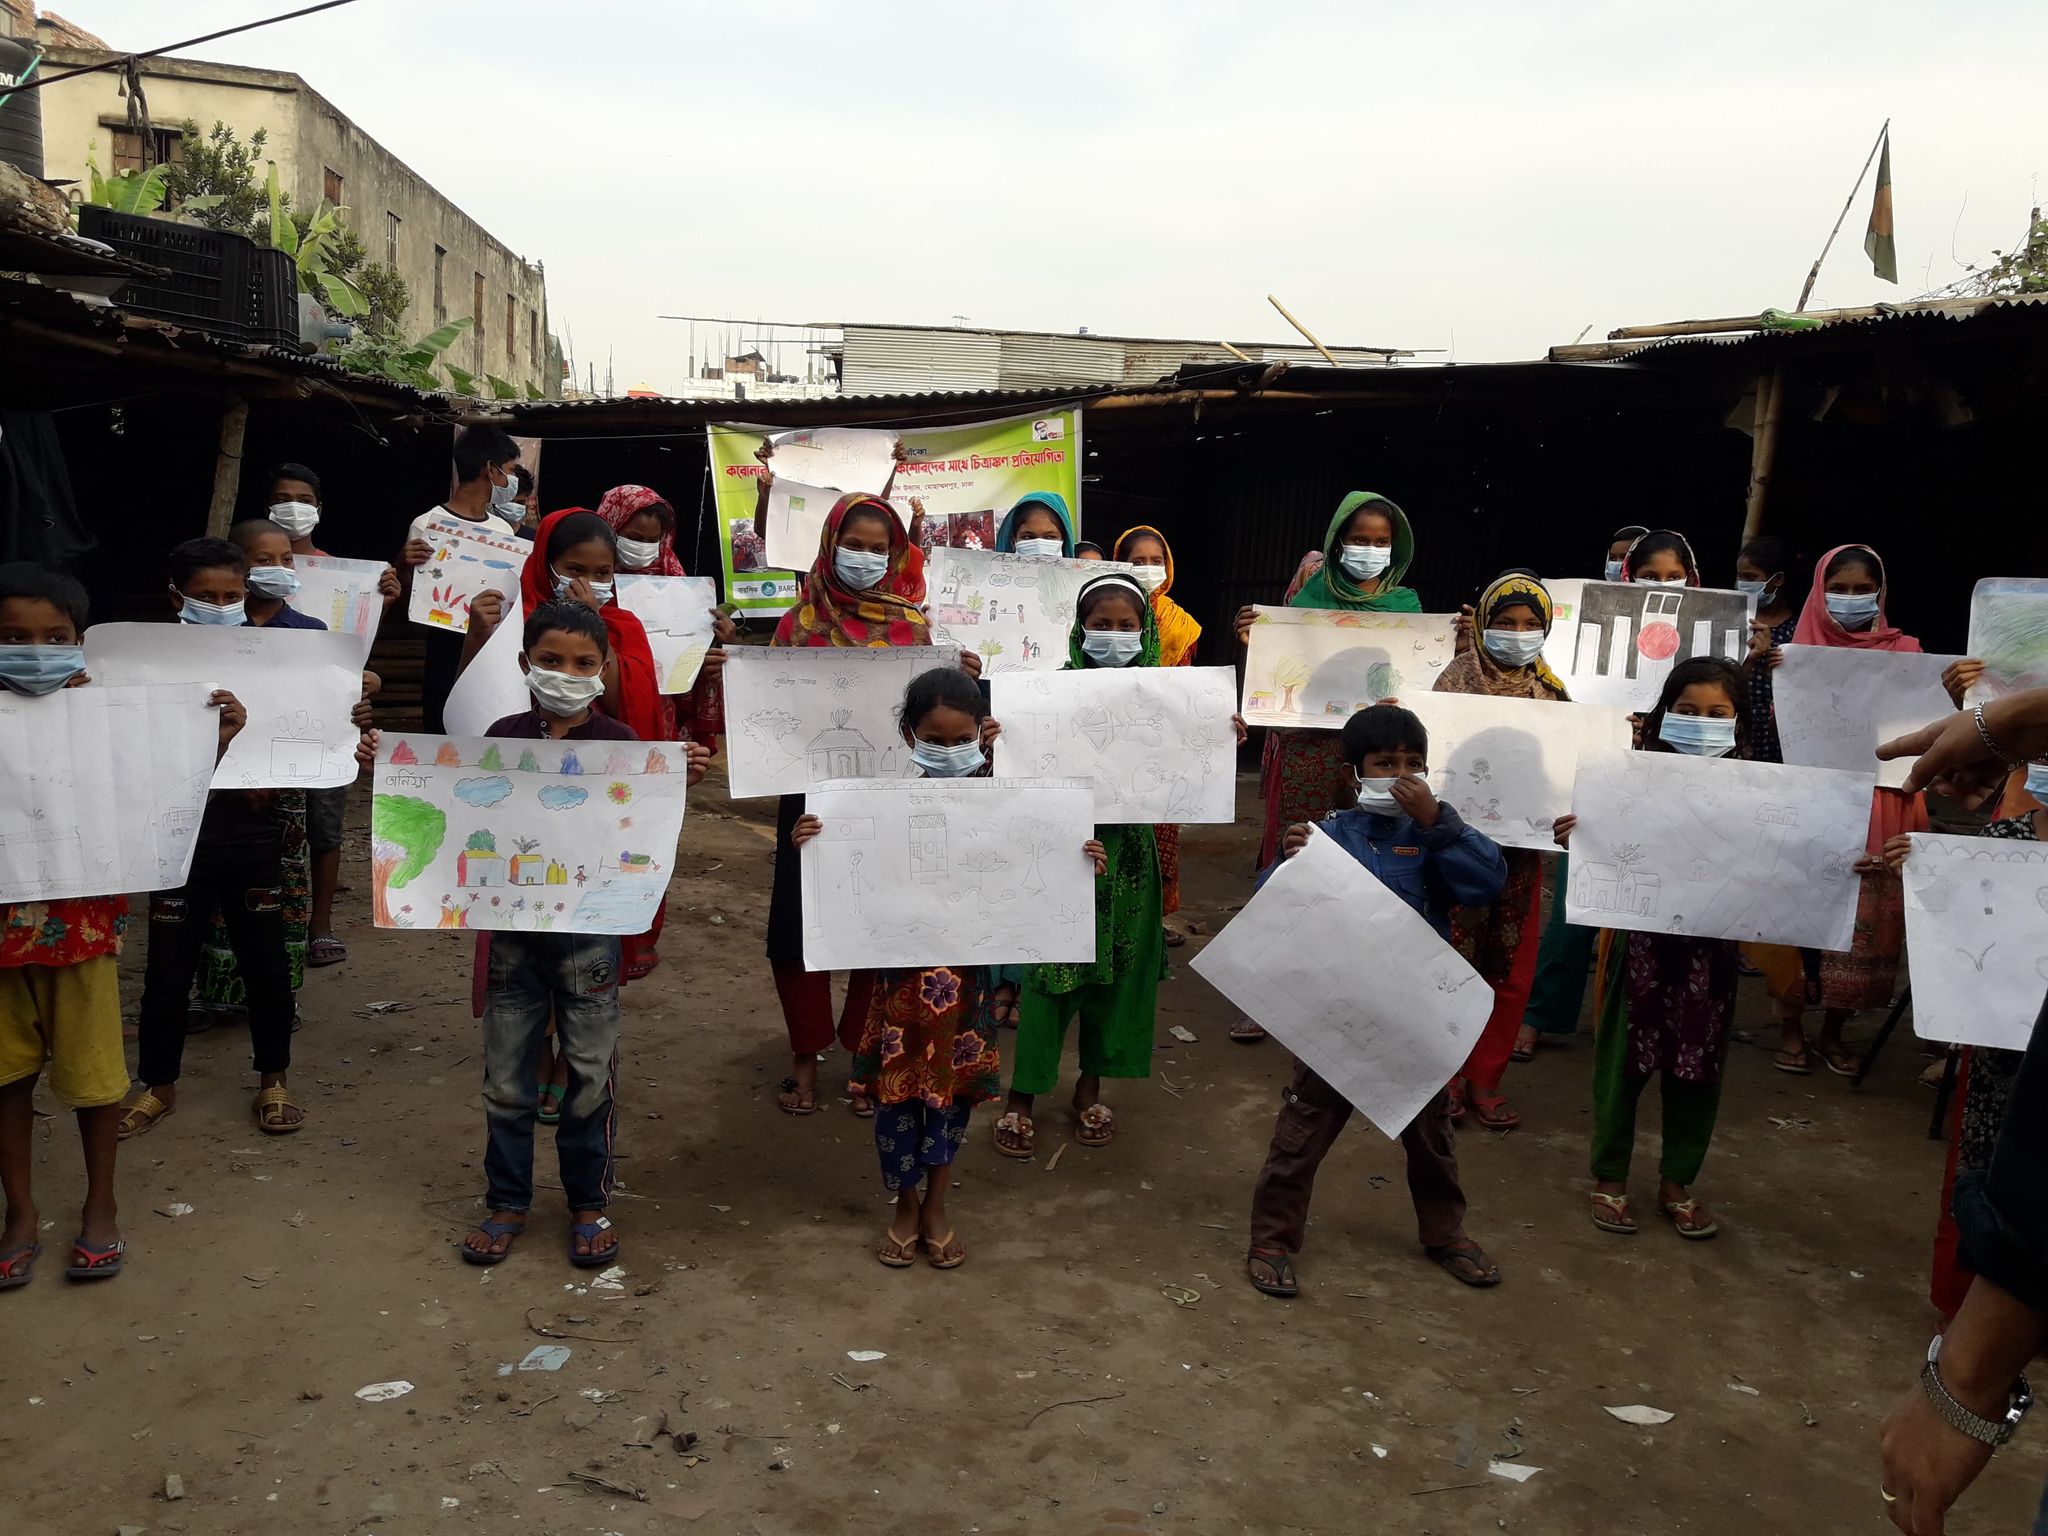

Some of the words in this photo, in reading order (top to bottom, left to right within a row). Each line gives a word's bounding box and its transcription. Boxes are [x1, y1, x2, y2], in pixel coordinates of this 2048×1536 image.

[896, 461, 945, 477] কশোরদের
[1011, 447, 1065, 468] প্রতিযোগিতা
[778, 585, 798, 593] BARC
